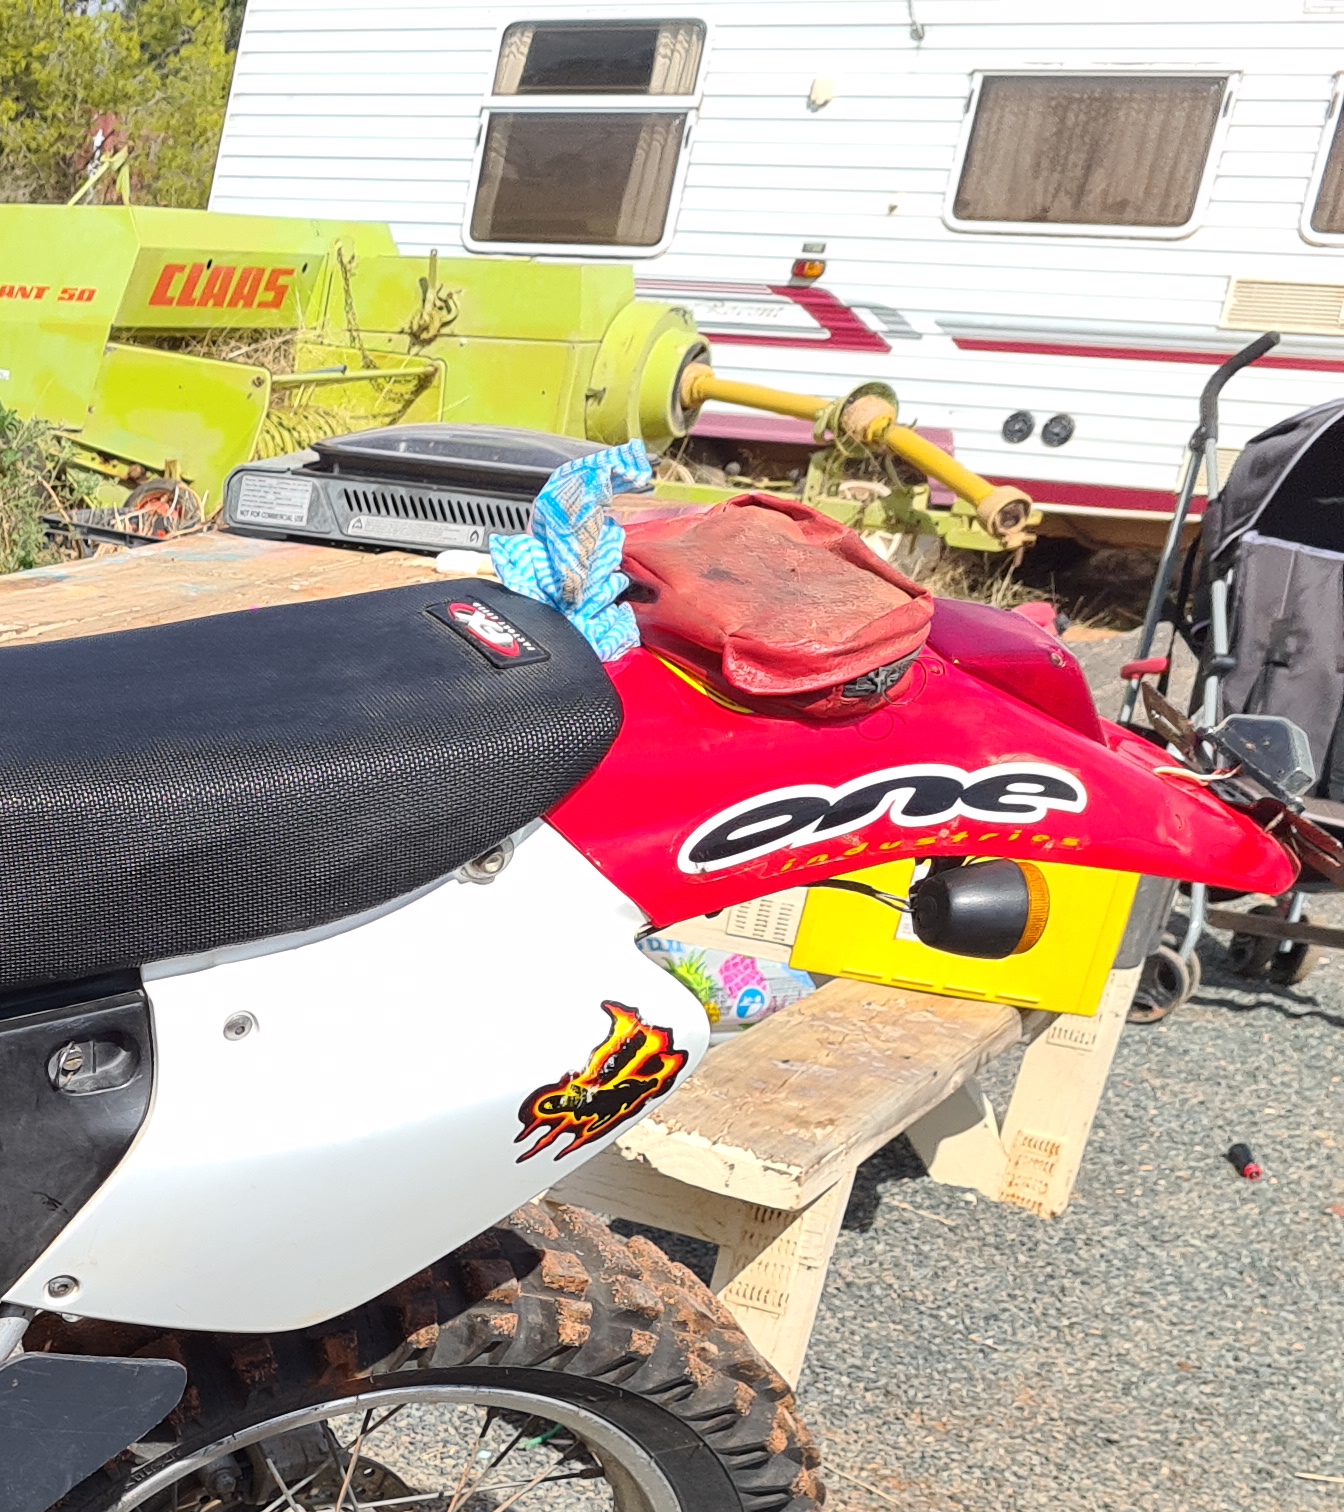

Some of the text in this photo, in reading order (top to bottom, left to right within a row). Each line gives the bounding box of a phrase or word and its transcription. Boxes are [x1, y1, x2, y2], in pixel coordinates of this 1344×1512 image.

[57, 287, 97, 303] 50
[149, 262, 295, 310] CLAAS
[680, 764, 1086, 872] one
[780, 832, 1082, 874] industries
